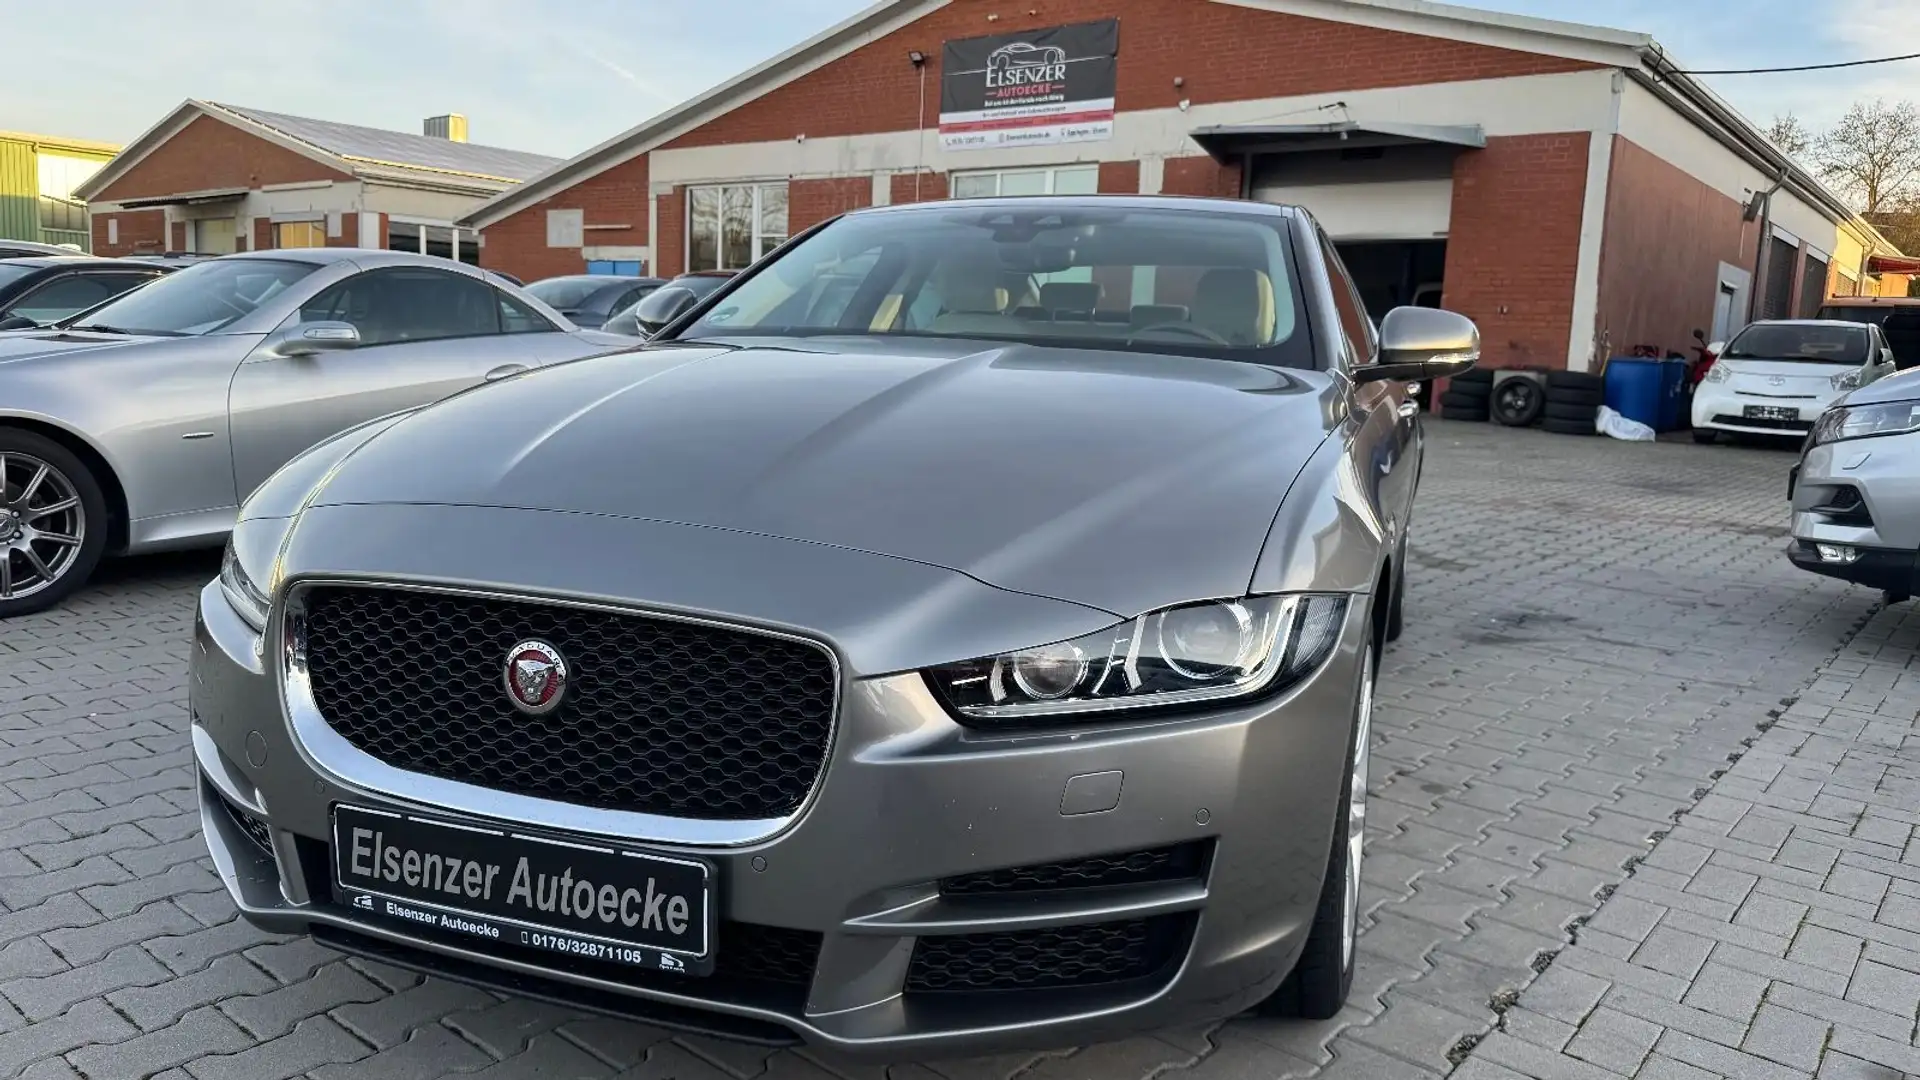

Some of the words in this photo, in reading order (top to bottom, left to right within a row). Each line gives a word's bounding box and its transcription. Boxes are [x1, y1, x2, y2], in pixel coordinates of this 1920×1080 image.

[986, 64, 1065, 87] ELSENZER
[997, 83, 1051, 97] AUTOECKE
[352, 827, 499, 900] Elsenzer
[506, 857, 689, 935] Autoecke
[386, 901, 437, 924] Elsenzer
[440, 914, 499, 938] Autoecke
[532, 933, 641, 963] 0176/32871105
